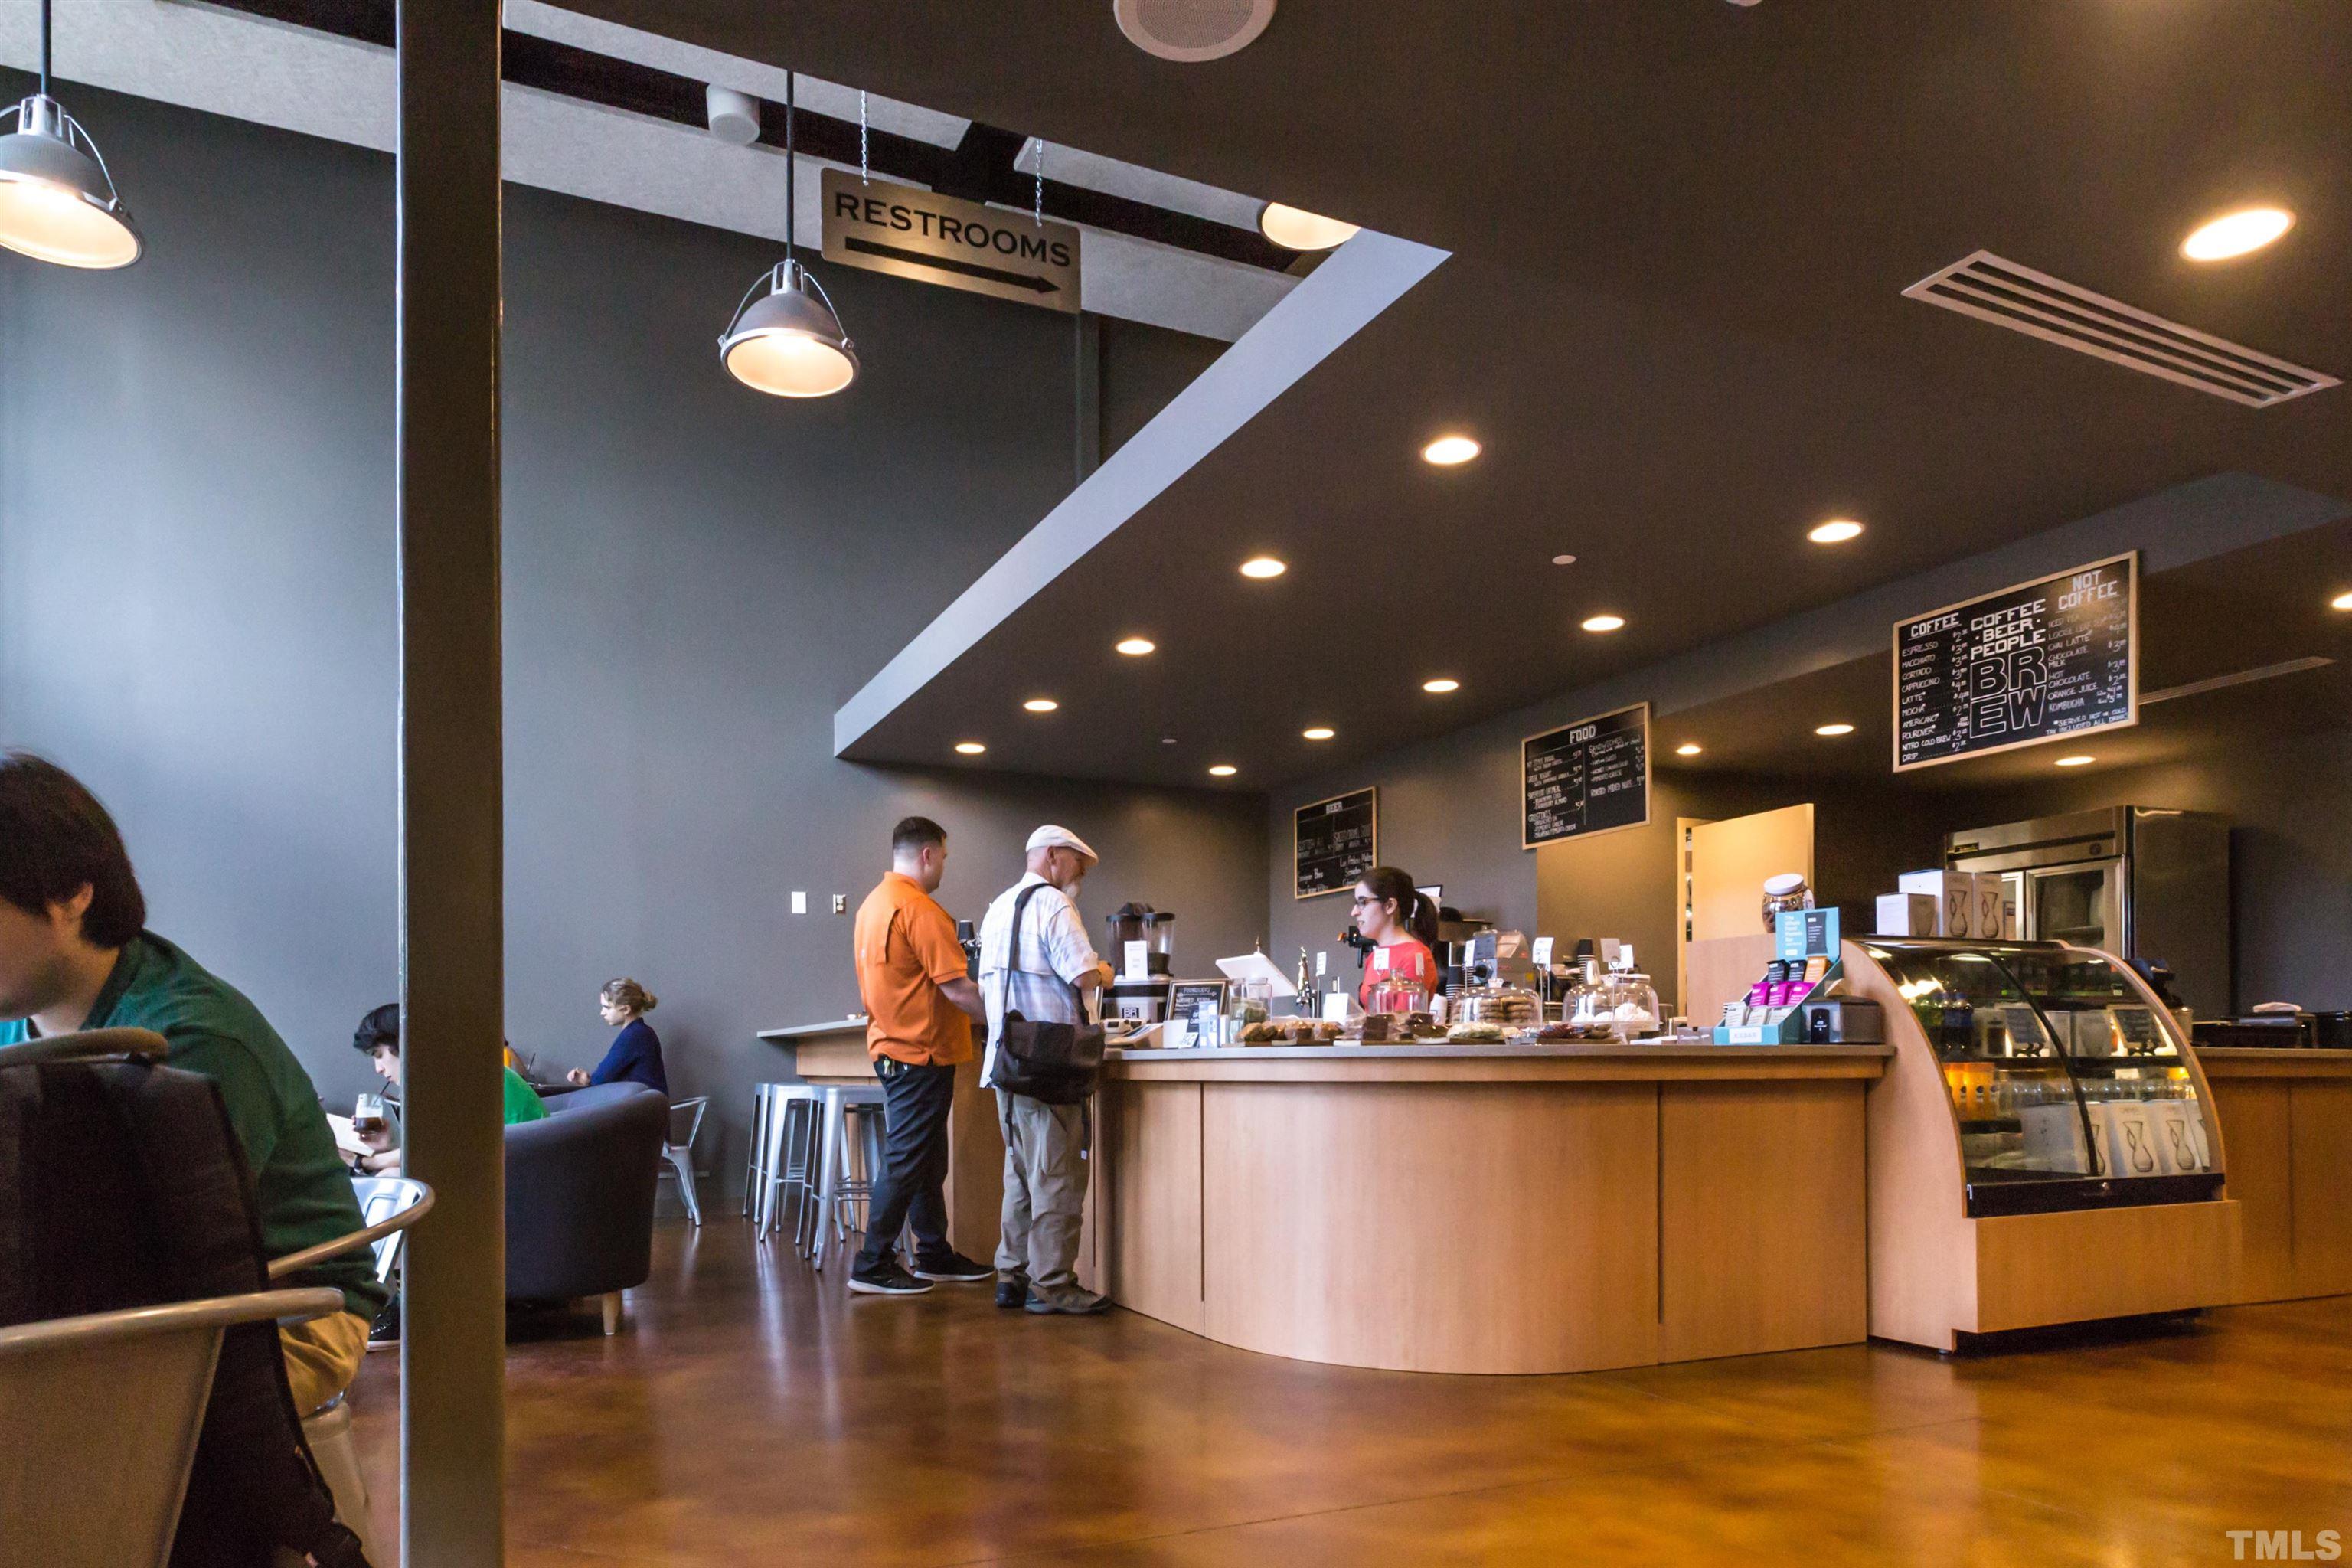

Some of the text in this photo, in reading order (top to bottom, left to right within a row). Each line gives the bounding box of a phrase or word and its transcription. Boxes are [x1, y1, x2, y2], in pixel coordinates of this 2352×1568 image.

[835, 193, 1070, 268] RESTROOMS
[2073, 570, 2102, 591] NOT
[2058, 580, 2117, 610] COFFEE
[1971, 598, 2046, 631] COFFEE
[1911, 612, 1959, 638] COFFEE
[1902, 641, 1939, 657] ESPRESSO
[1971, 629, 2046, 660] PEOPLE
[2048, 645, 2089, 662] CHOCOLATE
[2048, 671, 2092, 688] CHOCOLATE
[2049, 670, 2065, 680] HOT
[2047, 687, 2076, 700] ORANGE
[2078, 682, 2098, 694] JUICE
[1570, 725, 1596, 743] FOOD
[1902, 742, 1919, 751] NITRO
[1936, 735, 1952, 744] BREW
[1903, 752, 1918, 763] DRIP
